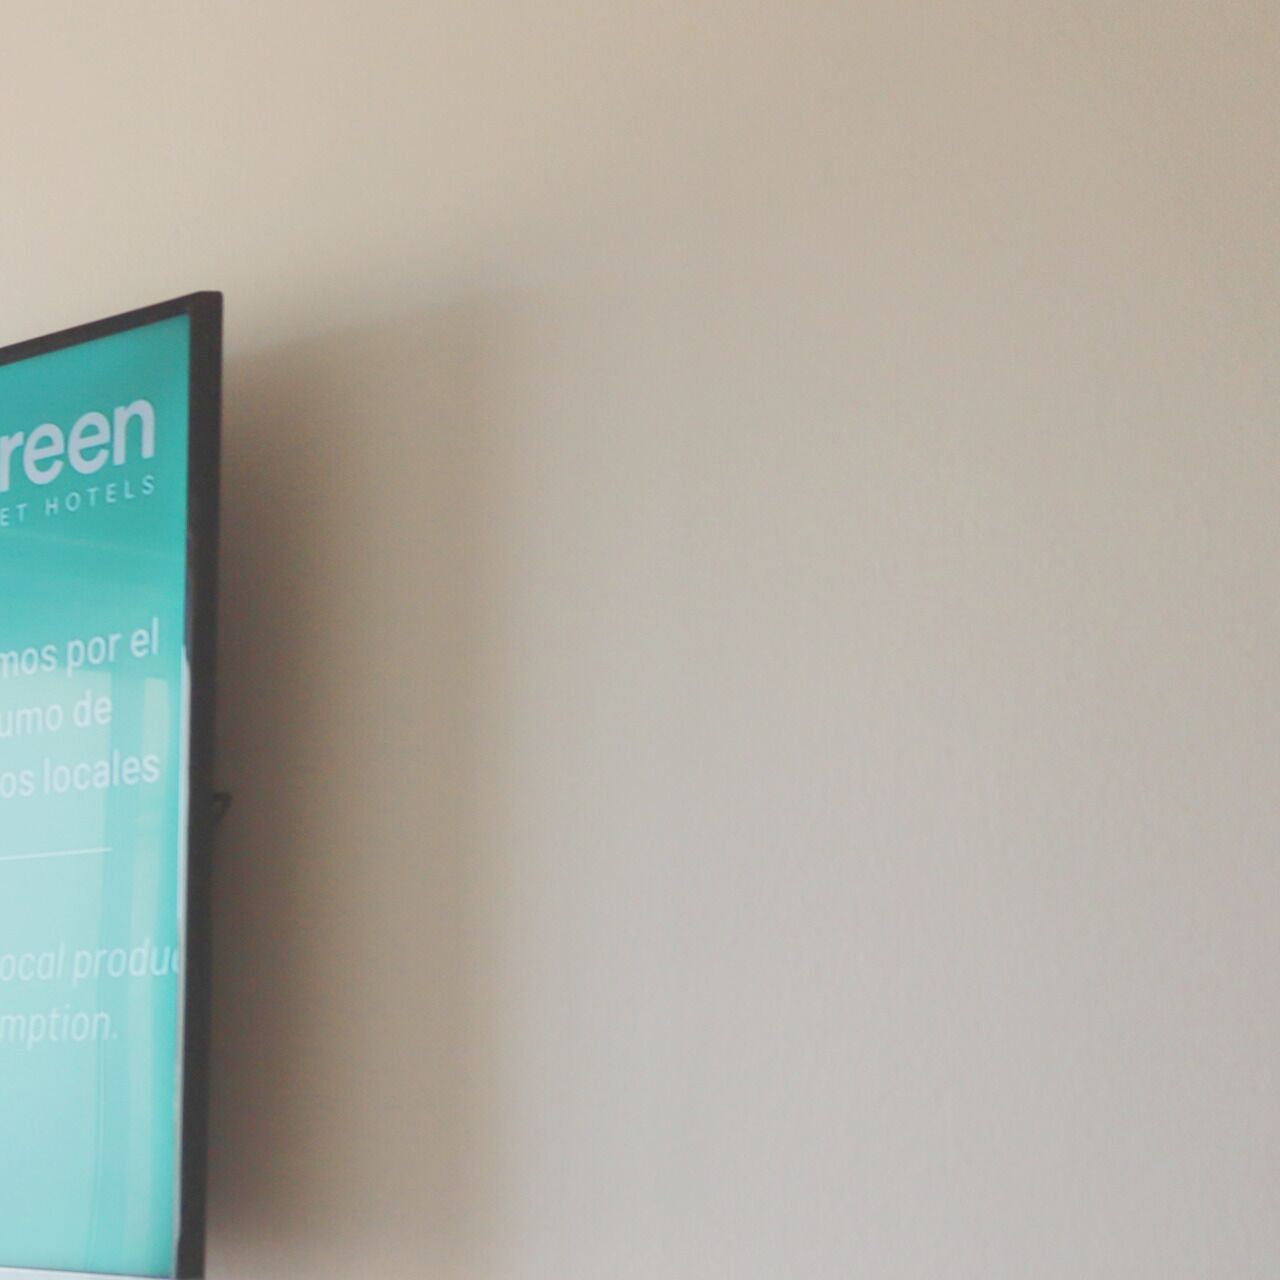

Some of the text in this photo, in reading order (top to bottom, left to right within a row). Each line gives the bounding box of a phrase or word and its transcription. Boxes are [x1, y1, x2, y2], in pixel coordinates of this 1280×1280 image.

[44, 474, 156, 516] HOTELS
[66, 630, 122, 677] por
[129, 616, 160, 658] el
[72, 690, 113, 727] de
[43, 749, 161, 794] locales
